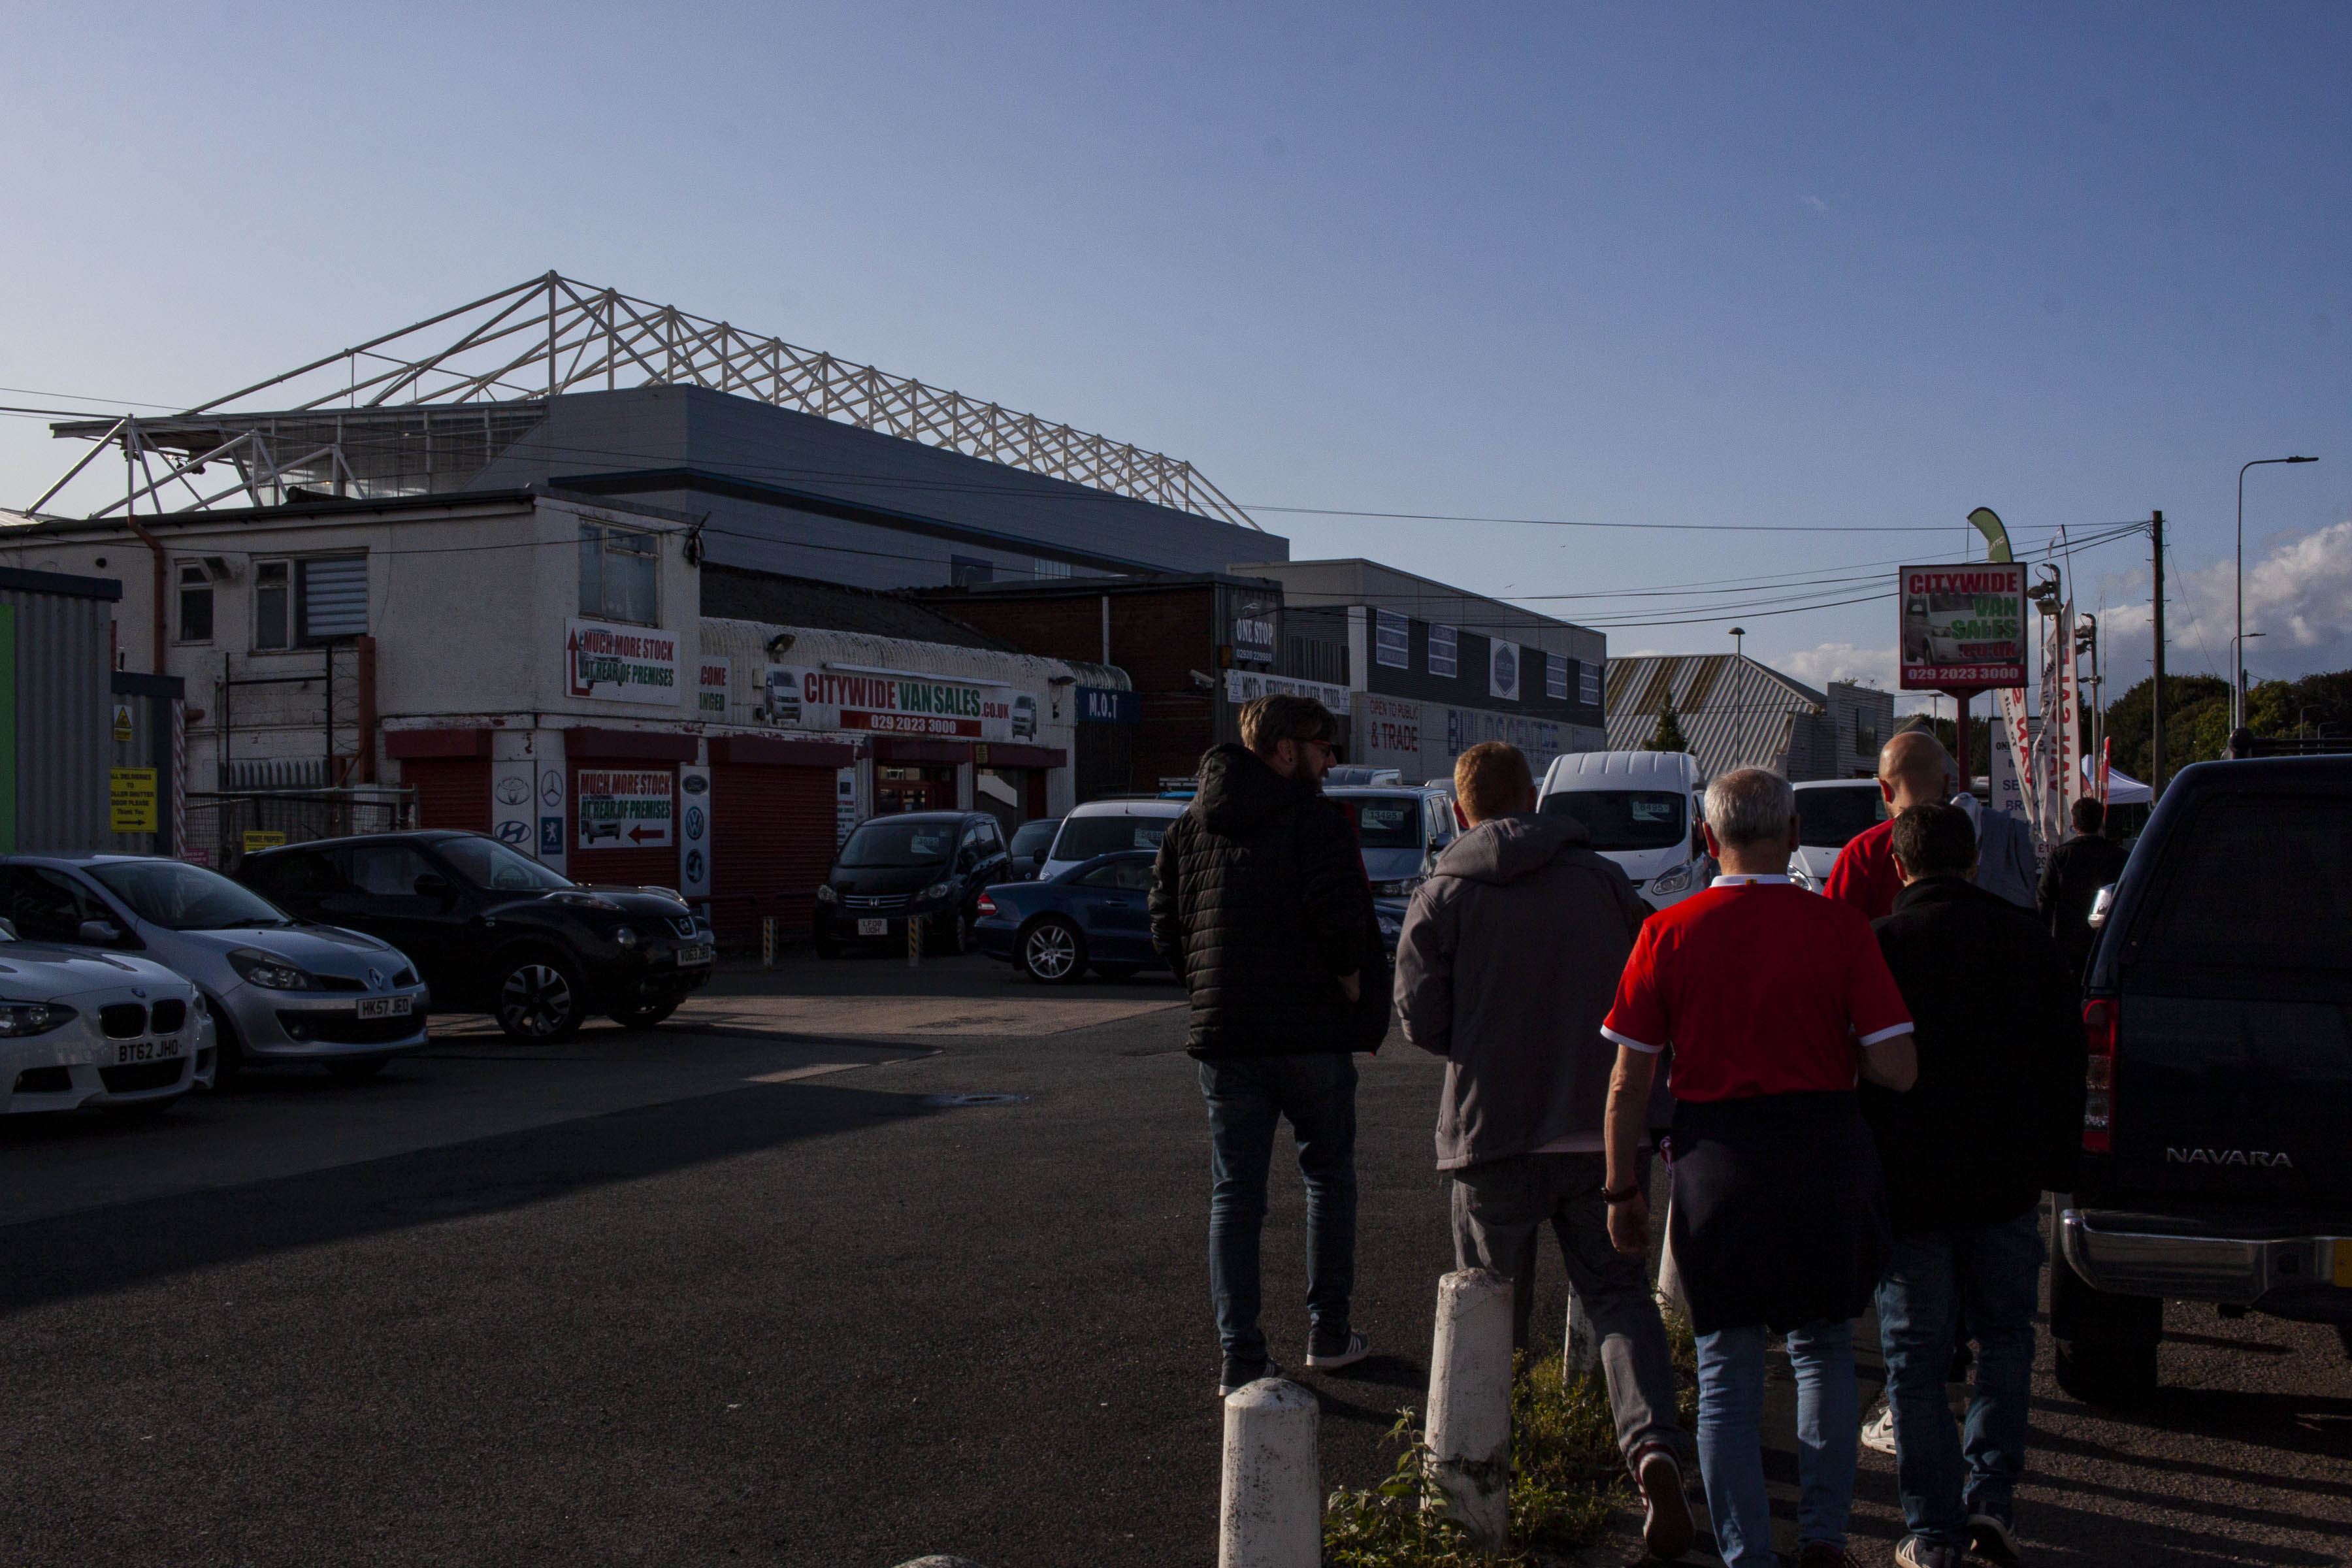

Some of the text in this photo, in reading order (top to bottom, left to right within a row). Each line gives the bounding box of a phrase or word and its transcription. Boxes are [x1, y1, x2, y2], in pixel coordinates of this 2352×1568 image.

[1909, 572, 2017, 594] CITYWIDE
[1973, 595, 2017, 617] VAN
[1236, 617, 1273, 645] ONE STOP
[1951, 619, 2017, 640] SALES
[583, 631, 674, 661] MUCH MORE STOCK
[1236, 648, 1252, 659] 02920
[584, 660, 674, 687] AT REAR OF PREMISES
[700, 666, 727, 686] COME
[1908, 667, 2019, 680] 029 2023 3000
[804, 672, 896, 710] CITYWIDE
[898, 682, 932, 713] VAN
[934, 685, 980, 717] SALES
[1088, 692, 1118, 719] M.O.T
[1369, 700, 1419, 721] OPEN TO PUBLIC
[871, 714, 956, 734] 029 2023 3000
[1371, 721, 1417, 753] & TRADE
[580, 773, 610, 795] MUCH
[612, 774, 639, 795] MORE
[640, 774, 670, 795] STOCK
[581, 800, 671, 819] AT REAR OF PREMISES
[363, 1000, 389, 1016] HK57
[119, 1039, 178, 1062] BT62 JHO
[2166, 1147, 2294, 1168] NAVARA
